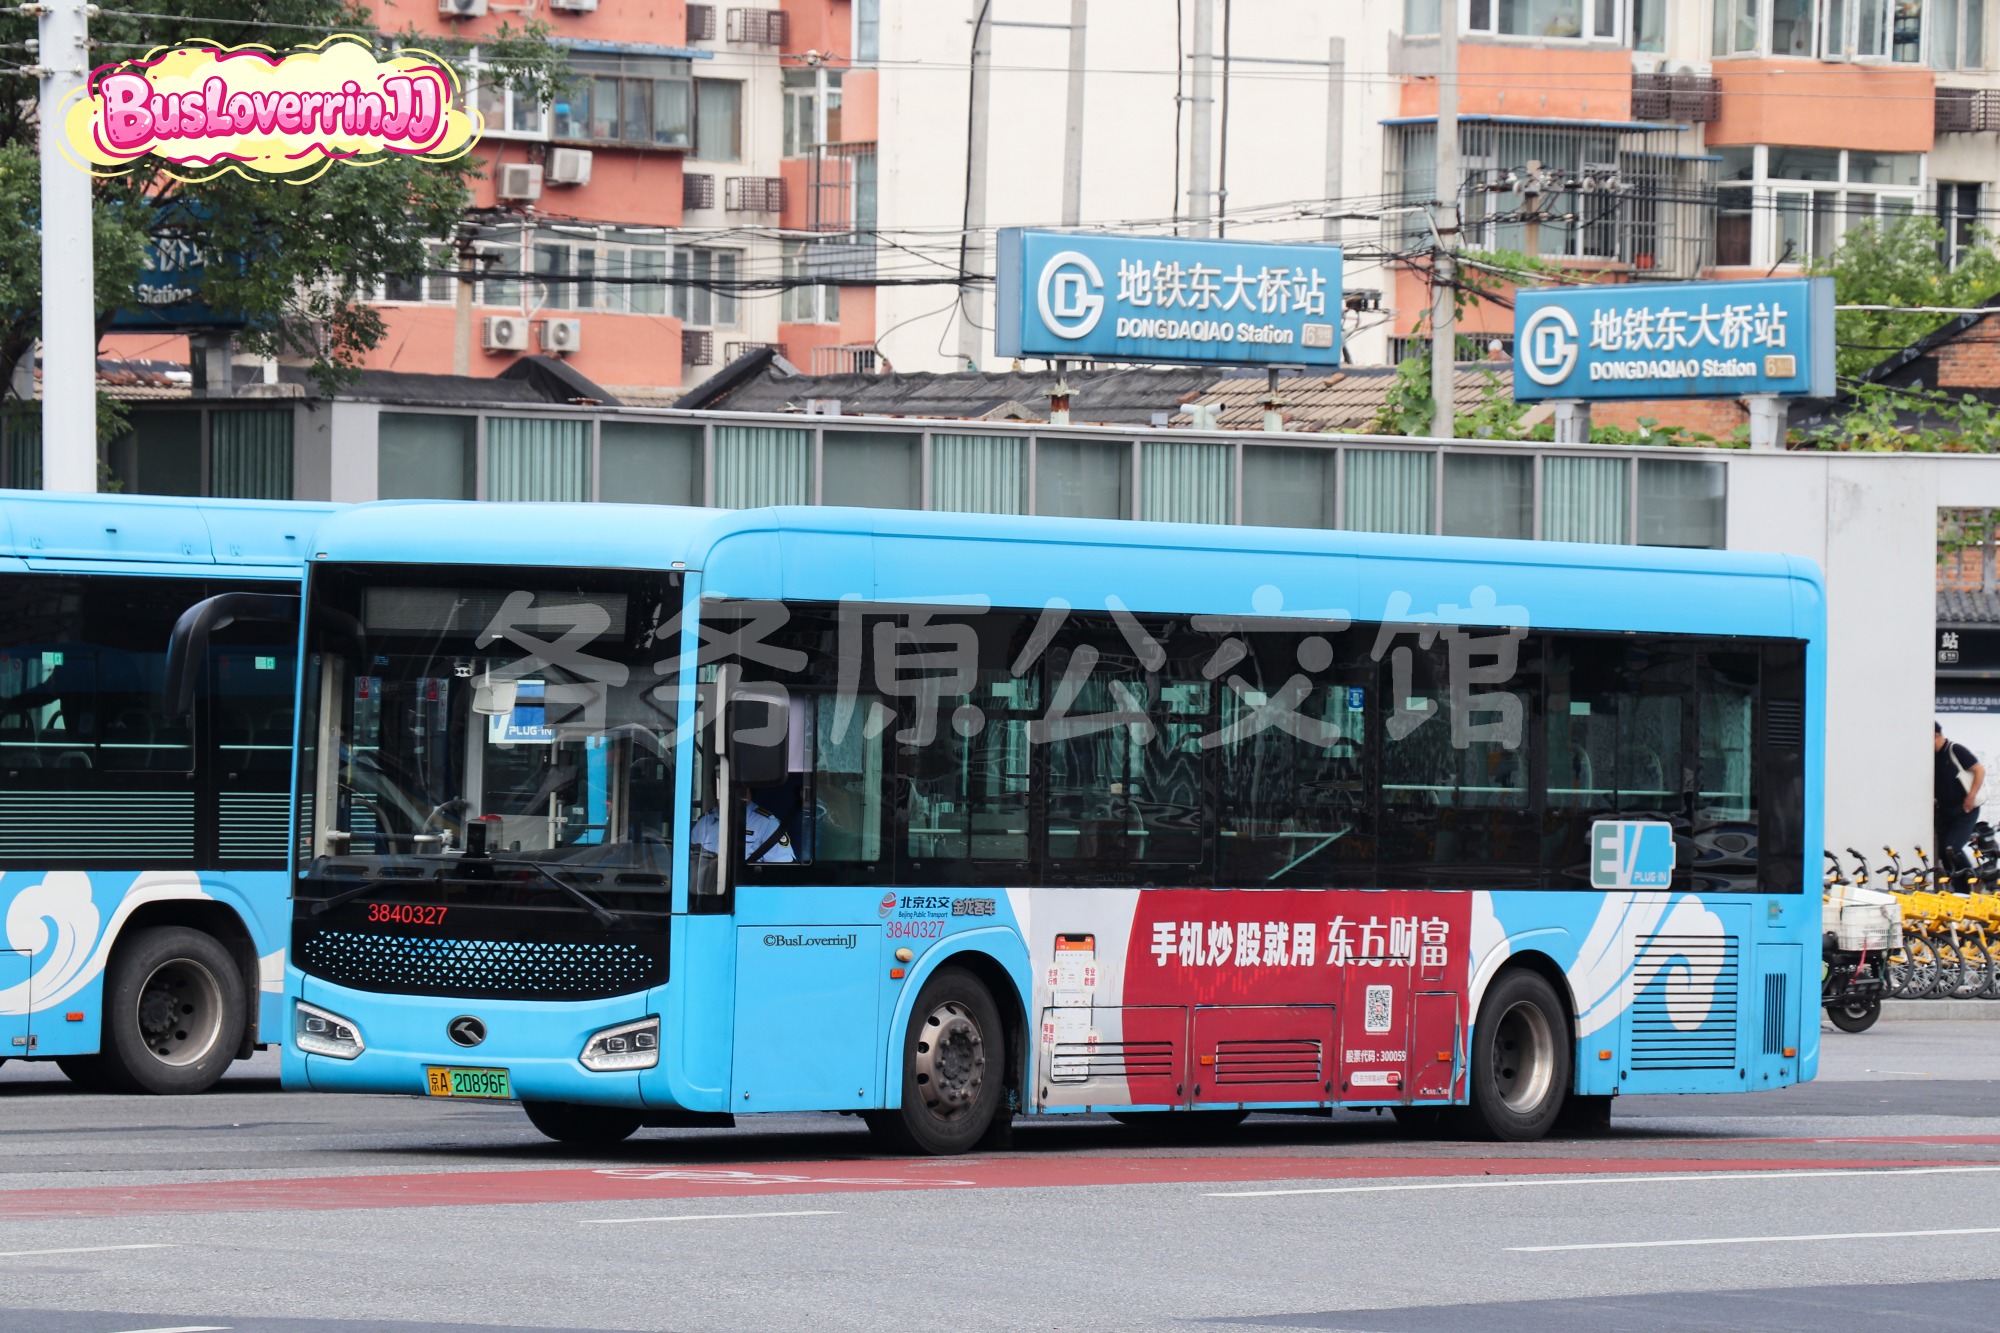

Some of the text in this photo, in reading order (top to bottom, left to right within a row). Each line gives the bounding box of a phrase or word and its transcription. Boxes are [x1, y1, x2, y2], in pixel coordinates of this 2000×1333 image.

[138, 284, 192, 303] Station
[1117, 258, 1327, 316] 地铁东大桥站
[1116, 317, 1235, 342] DONGDAQIAO
[1236, 322, 1294, 345] Station
[1589, 302, 1788, 351] 地铁东大桥站
[1590, 359, 1700, 381] DONGDAQIAO
[1702, 357, 1757, 378] Station
[1942, 632, 1959, 649] 站
[368, 903, 448, 925] 3840327
[899, 911, 913, 920] Beijing
[927, 911, 948, 919] Transport
[900, 896, 996, 916] 北京公交 金龙客车
[886, 921, 945, 938] 3840327
[1150, 915, 1449, 967] 手机炒股就用 东方财富
